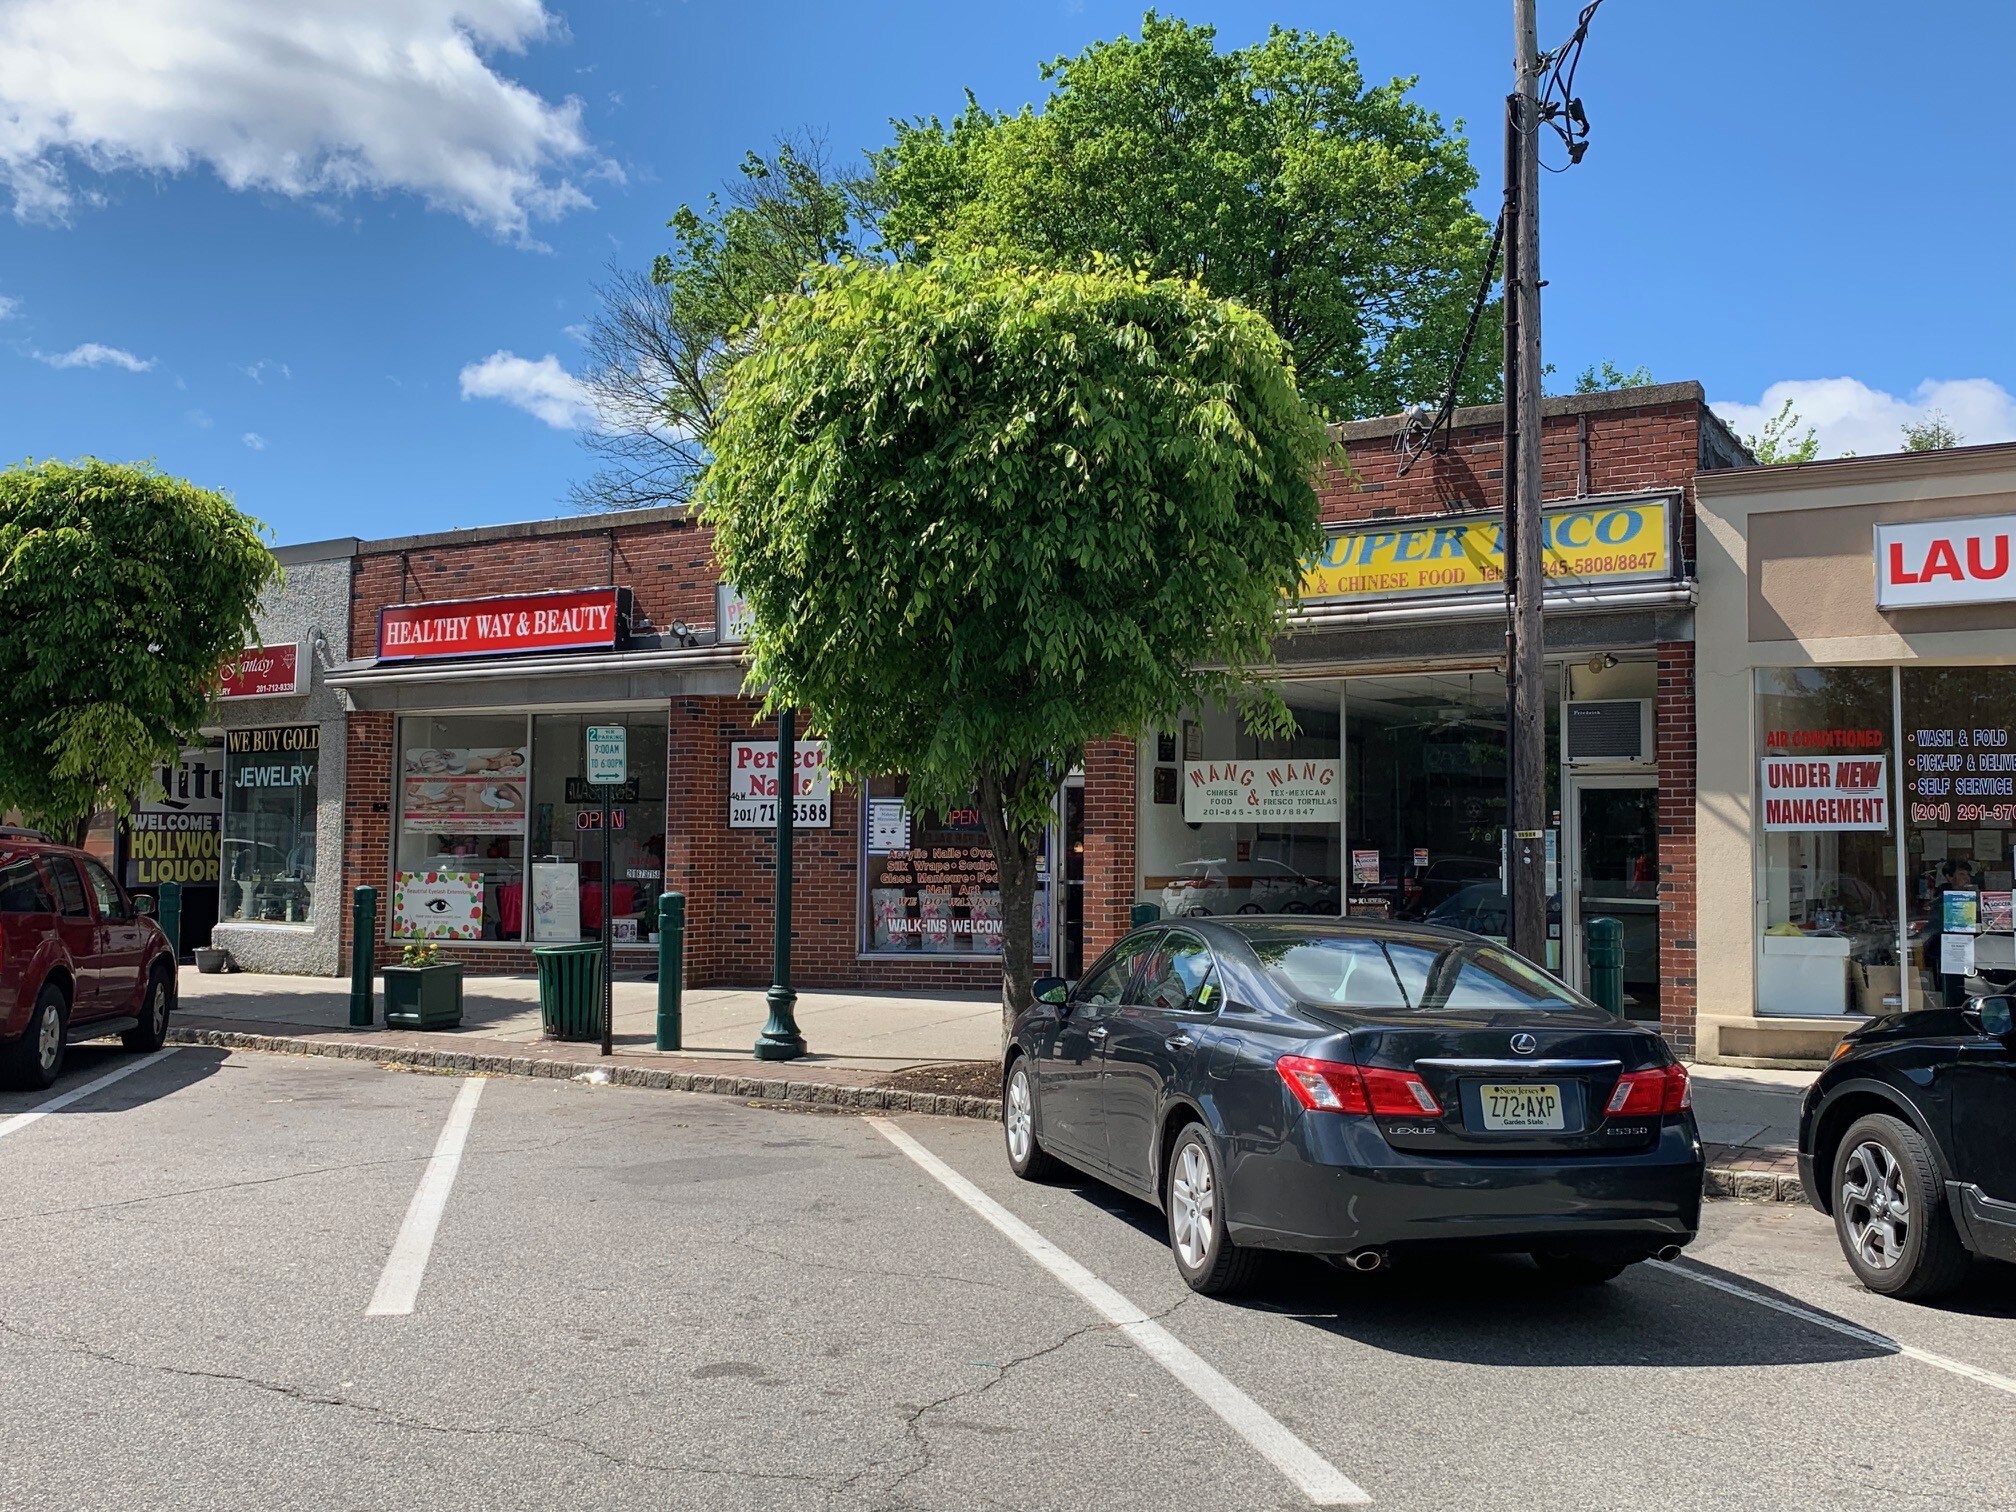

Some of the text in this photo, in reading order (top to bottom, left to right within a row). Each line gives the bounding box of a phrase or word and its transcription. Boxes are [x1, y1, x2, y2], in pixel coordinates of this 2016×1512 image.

[1301, 525, 1466, 569] UPER
[1889, 535, 2010, 585] LAU
[1338, 572, 1409, 592] CHINESE
[1417, 568, 1466, 587] FOOD
[386, 604, 612, 646] HEALTHY WAY & BEAUTY
[228, 727, 320, 753] WE BUY GOLD
[589, 729, 597, 741] 2
[1766, 730, 1883, 748] AIR CONDITIONED
[1917, 729, 2008, 747] WASH & FOLD
[591, 758, 598, 768] TO
[737, 746, 826, 769] Perect
[1917, 754, 1962, 772] PICK-UP
[1967, 754, 1976, 771] &
[235, 765, 314, 788] JEWELRY
[1189, 762, 1334, 788] WANG WANG
[1768, 762, 1883, 789] UNDER NEW
[750, 774, 813, 796] Nals
[1917, 778, 2013, 795] SELF SERVICE
[1247, 788, 1260, 806] &
[577, 811, 623, 829] OPN
[1766, 798, 1884, 824] MANAGEMENT
[1911, 803, 1951, 822] (201)
[131, 814, 212, 831] WELCOME
[131, 831, 222, 858] HOLLYWOO
[888, 847, 995, 862] Acrylic Nails Ove
[138, 859, 219, 883] LIQUOR
[886, 860, 998, 873] Silk Wraps Sculpt
[880, 872, 1000, 883] Glass Manicure Ped
[925, 884, 981, 895] Nail Art
[899, 897, 999, 906] WE DO WAXING
[887, 918, 1003, 934] WALK-INS WELCOM
[1499, 1086, 1540, 1095] New Jersey
[1389, 1127, 1648, 1136] LEXUS ES350
